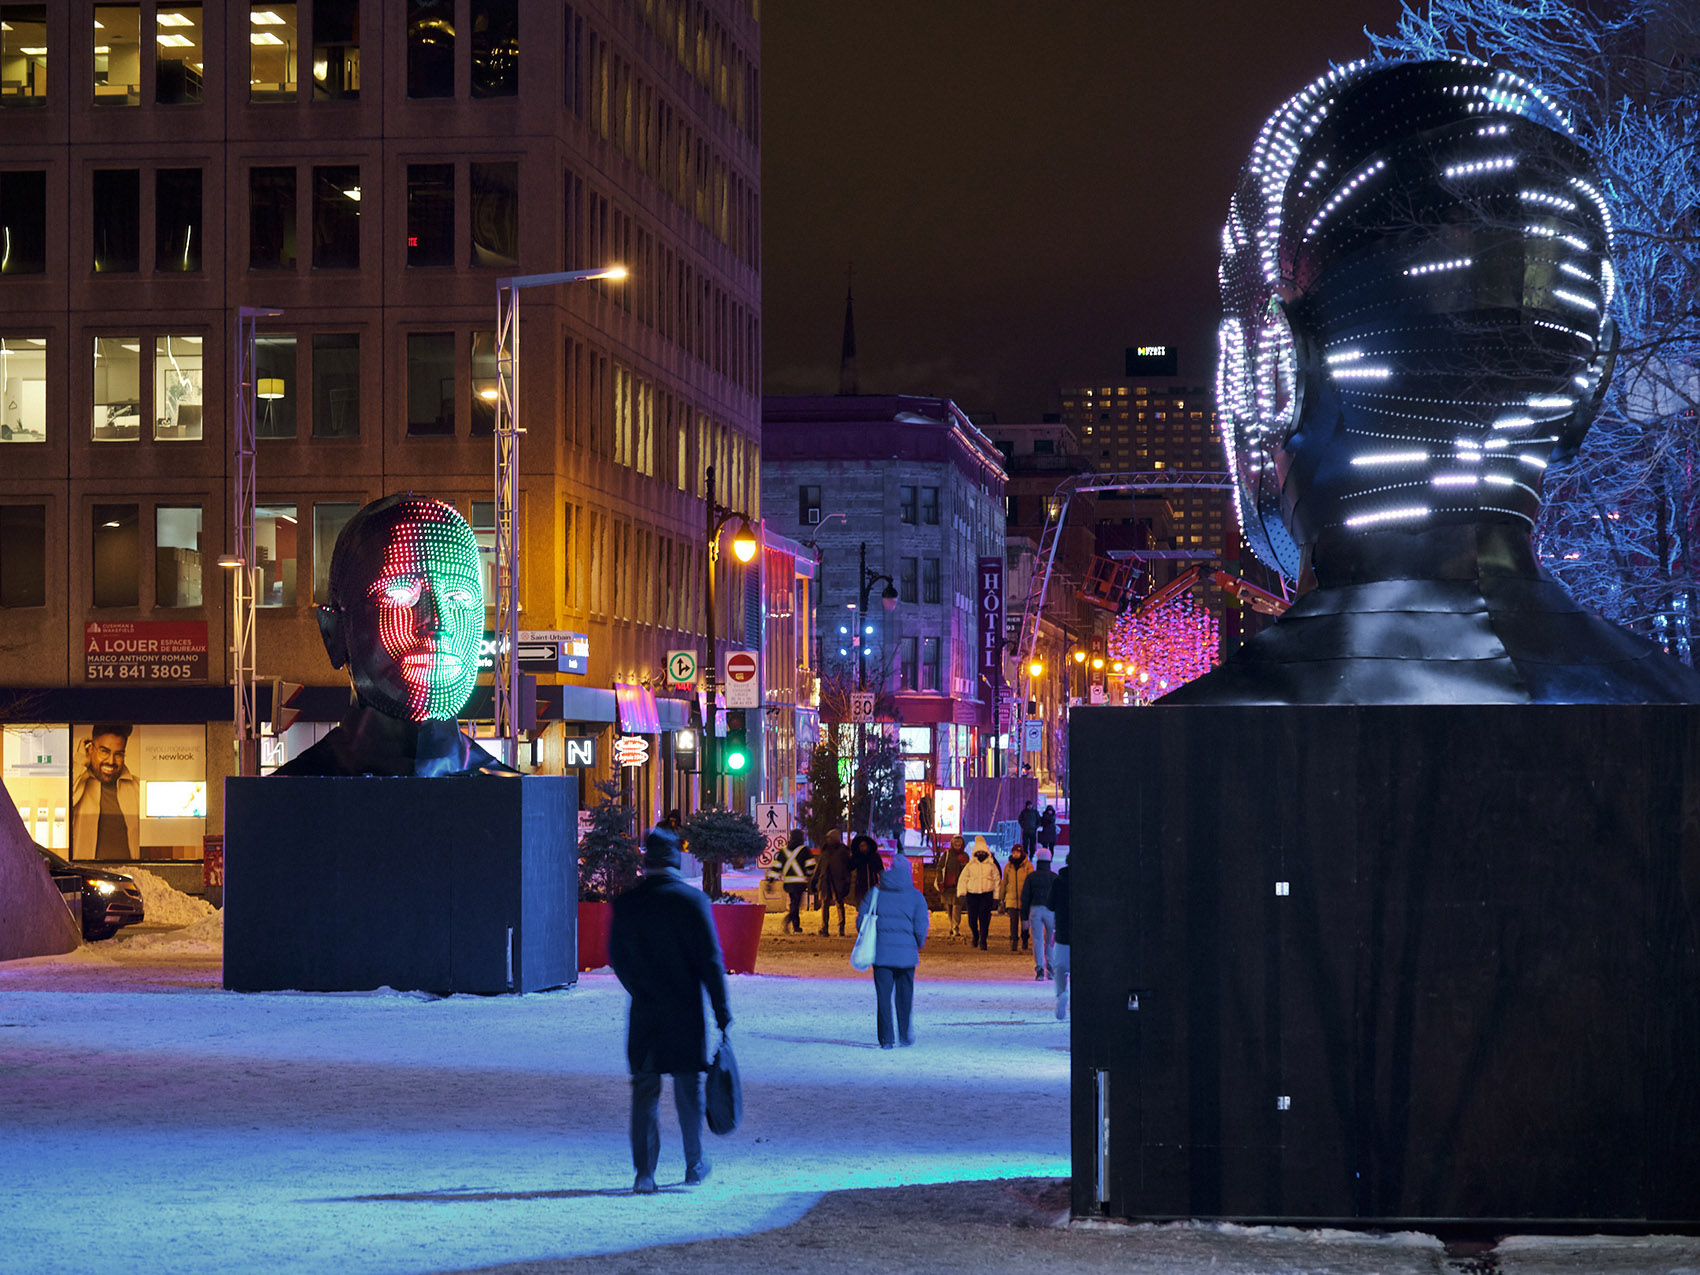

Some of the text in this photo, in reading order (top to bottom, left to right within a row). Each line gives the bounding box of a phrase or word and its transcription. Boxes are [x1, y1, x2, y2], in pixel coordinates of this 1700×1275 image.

[983, 573, 1000, 667] HÔTEL
[88, 637, 158, 652] À LOUER
[88, 665, 191, 679] 514 841 3805
[854, 700, 872, 715] 30
[567, 740, 592, 765] N
